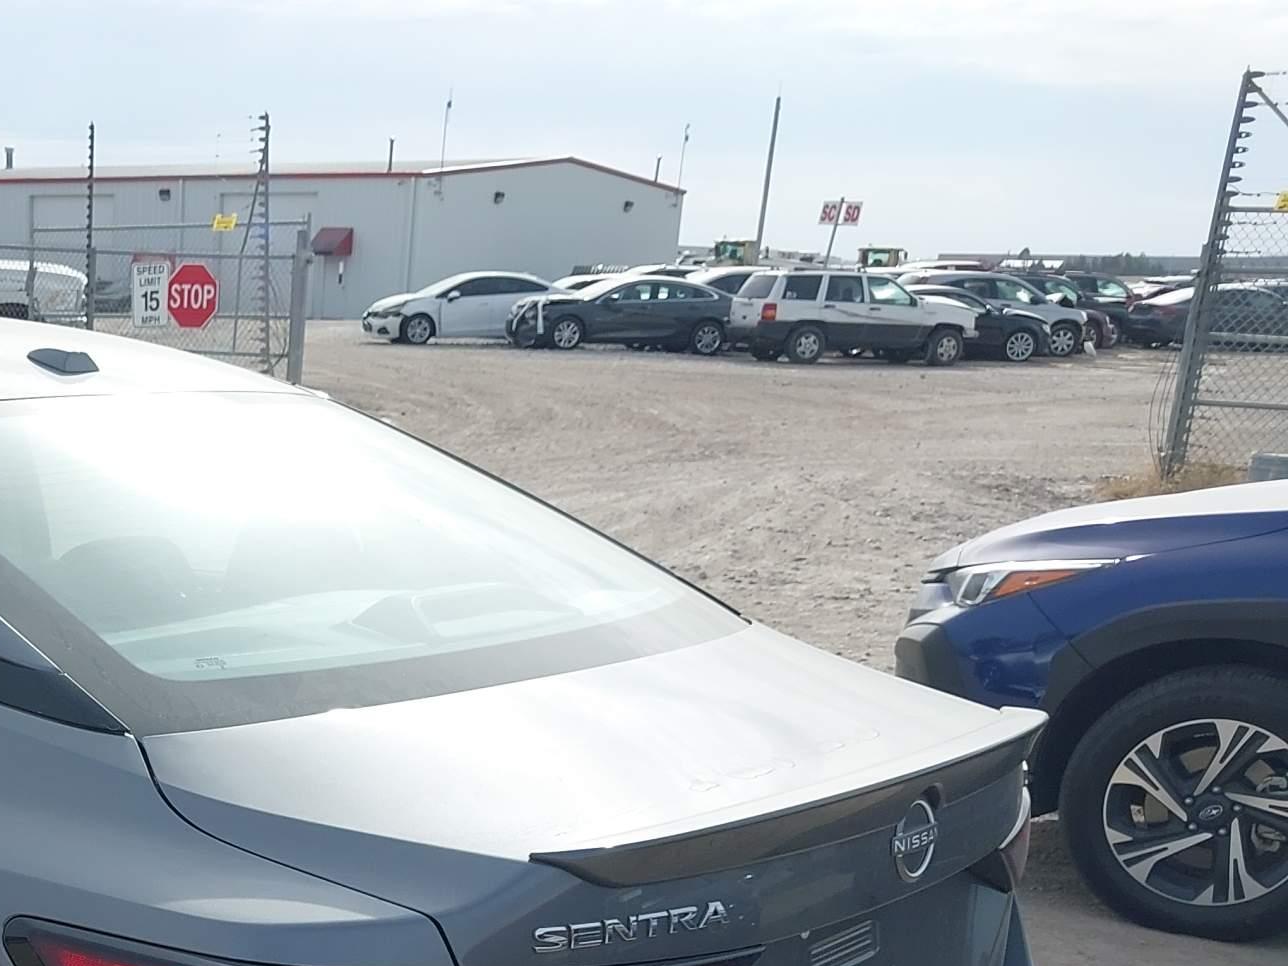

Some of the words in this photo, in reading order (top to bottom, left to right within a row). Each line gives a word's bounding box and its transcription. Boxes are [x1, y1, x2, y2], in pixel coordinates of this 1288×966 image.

[820, 204, 837, 222] SC
[843, 204, 861, 222] SD
[136, 265, 165, 276] SPEED
[139, 277, 161, 287] LIMIT
[141, 290, 160, 312] 15
[169, 283, 215, 309] STOP
[141, 316, 161, 325] MPH
[533, 900, 730, 953] SENTRA
